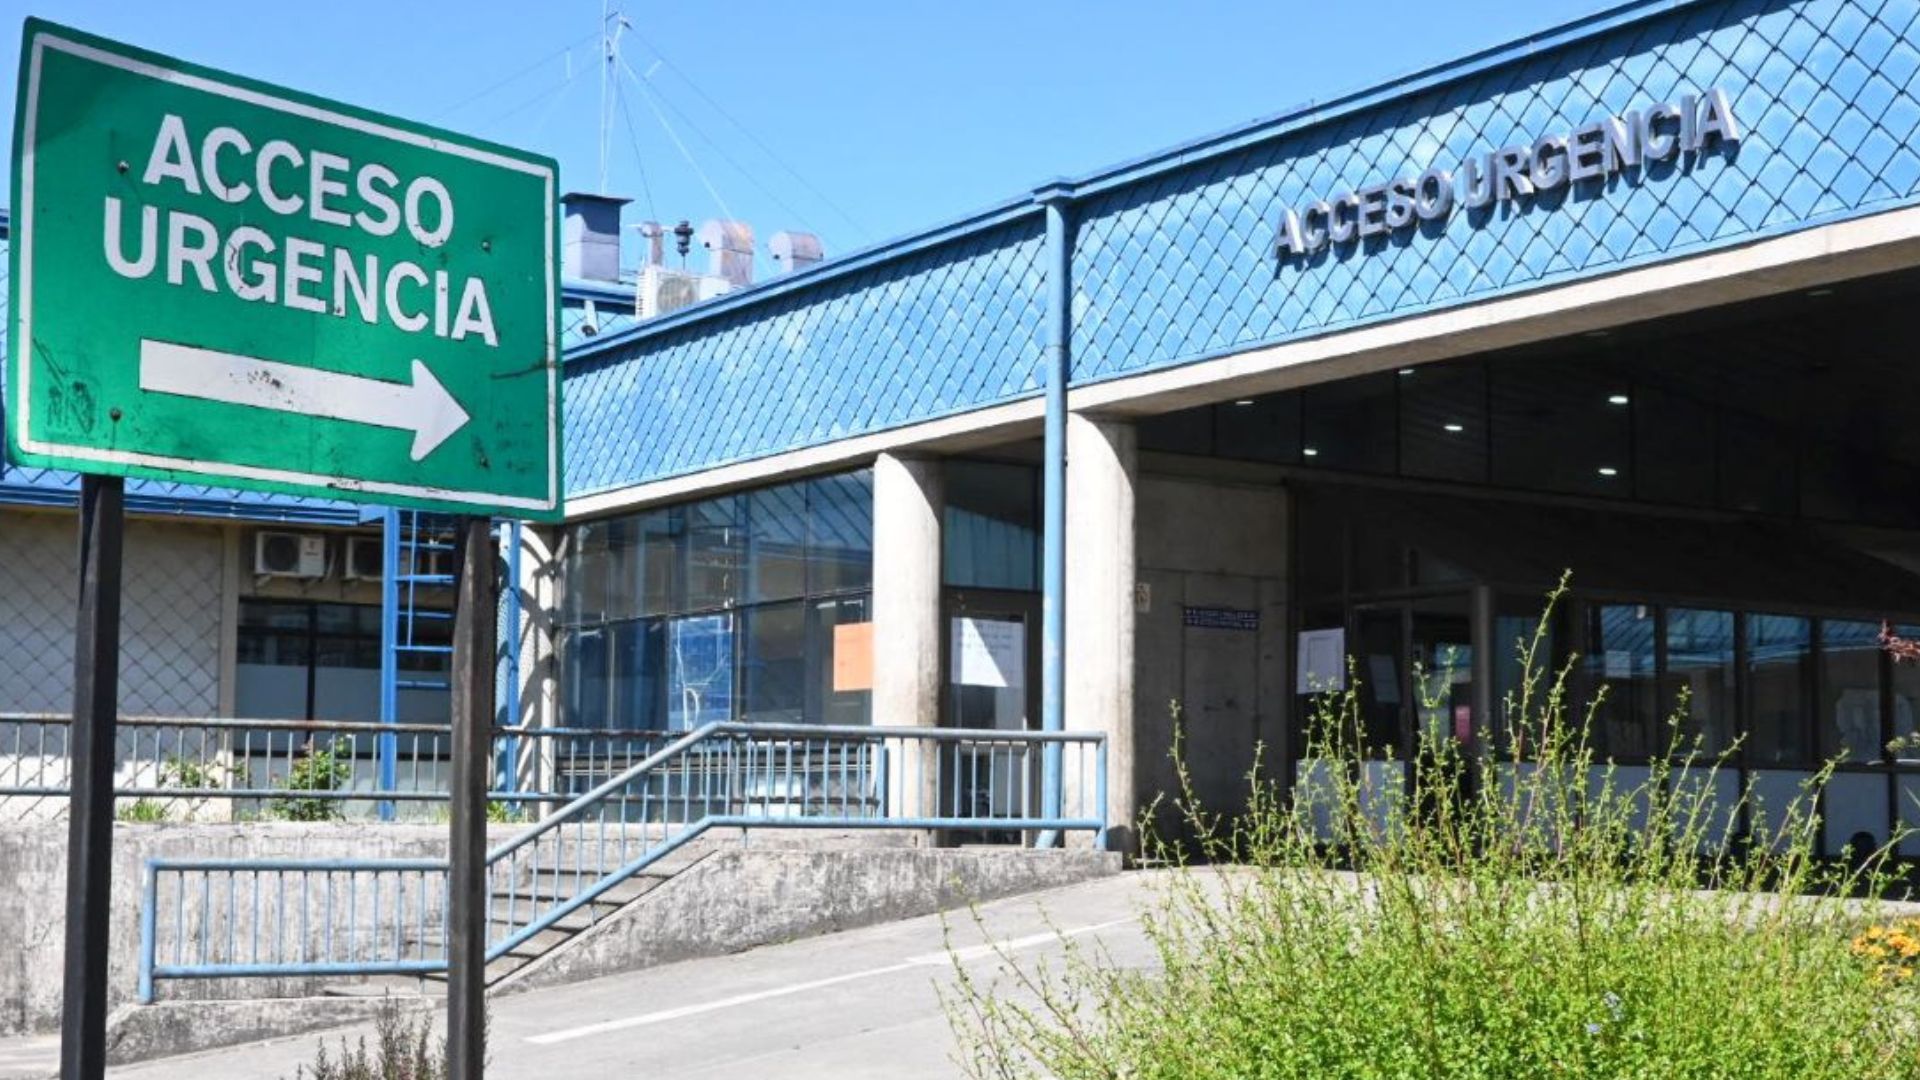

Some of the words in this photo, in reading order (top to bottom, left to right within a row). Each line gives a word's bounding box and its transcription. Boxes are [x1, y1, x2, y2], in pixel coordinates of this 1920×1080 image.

[143, 114, 454, 248] ACCESO
[1275, 169, 1453, 256] ACCESO
[1463, 88, 1740, 208] URGENCIA
[104, 197, 498, 347] URGENCIA
